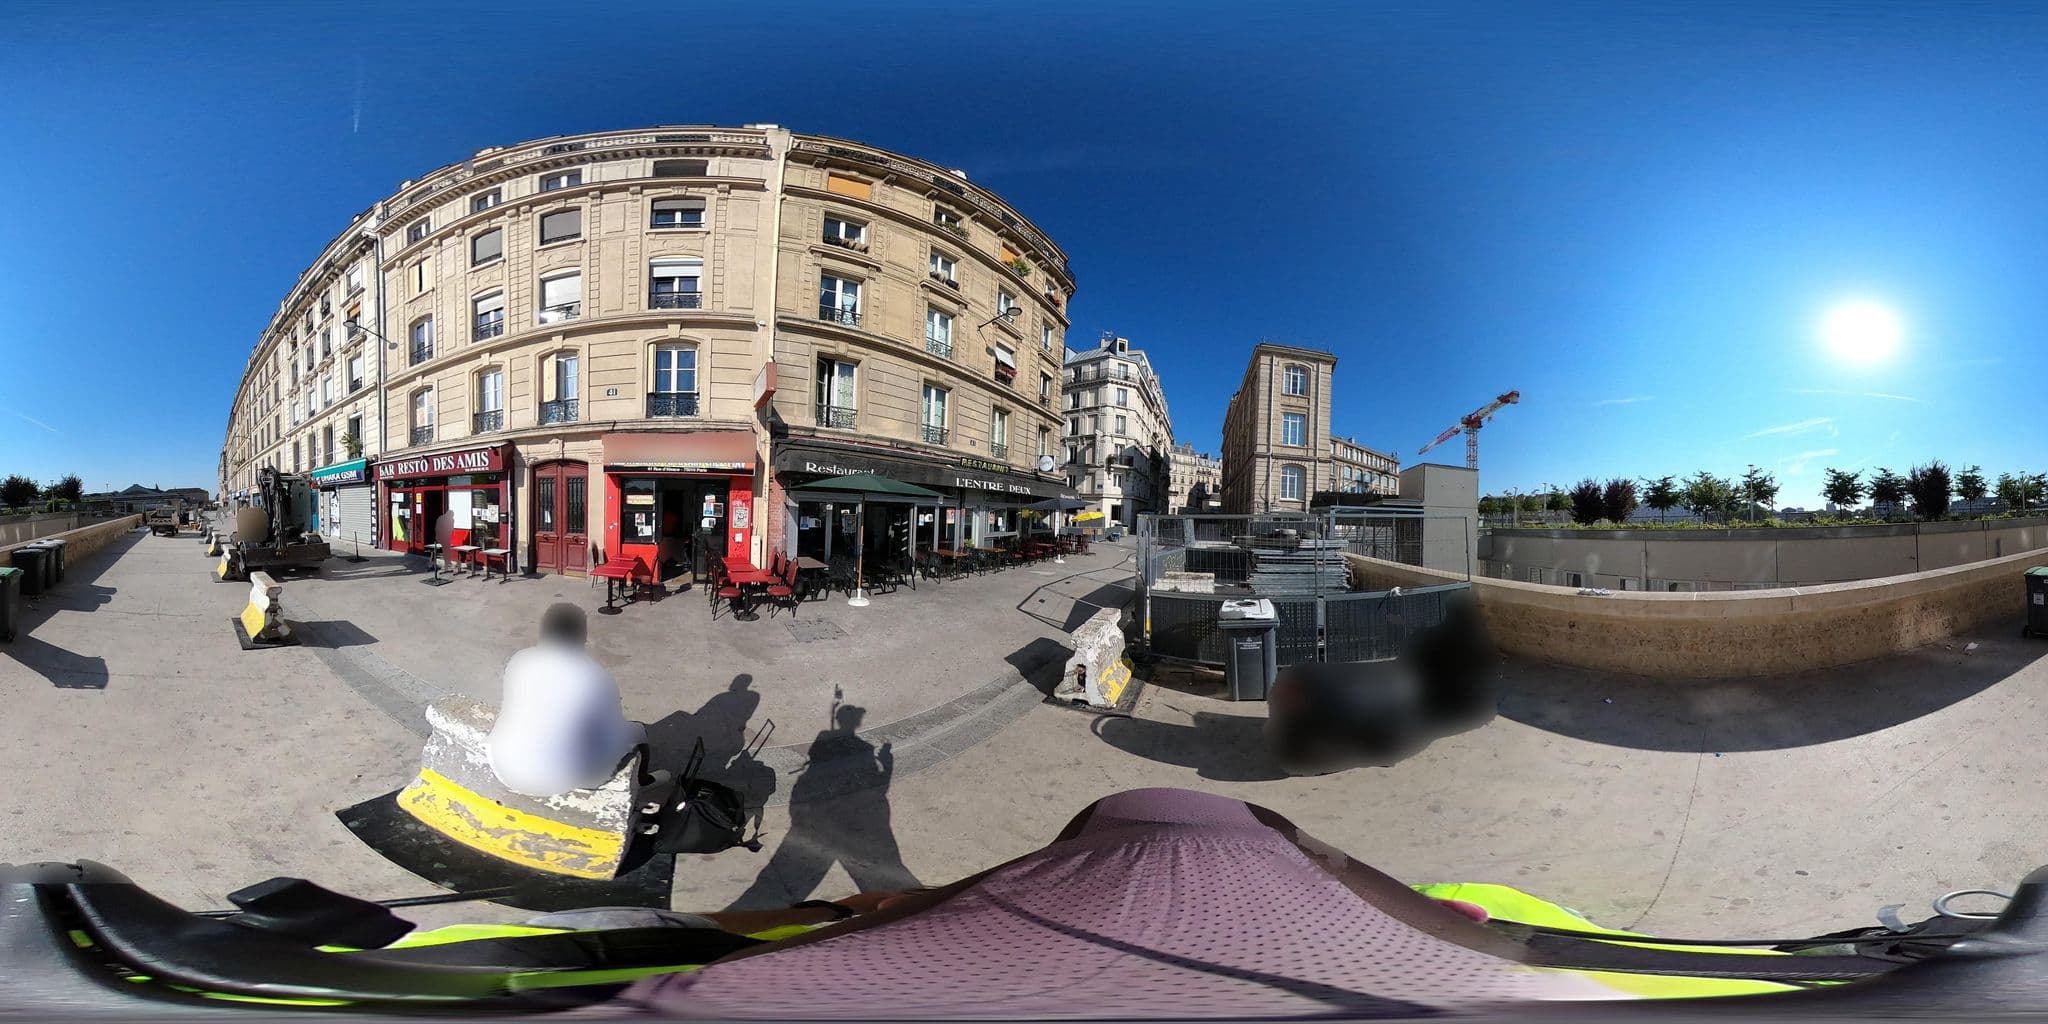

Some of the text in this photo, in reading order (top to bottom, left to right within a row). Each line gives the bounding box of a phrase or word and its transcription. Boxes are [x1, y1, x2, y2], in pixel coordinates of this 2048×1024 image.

[379, 463, 395, 476] BAR
[433, 455, 454, 471] DES
[456, 451, 489, 469] AMIS
[805, 461, 875, 476] Restaurt
[956, 477, 1031, 495] L'ENTRE DEUX
